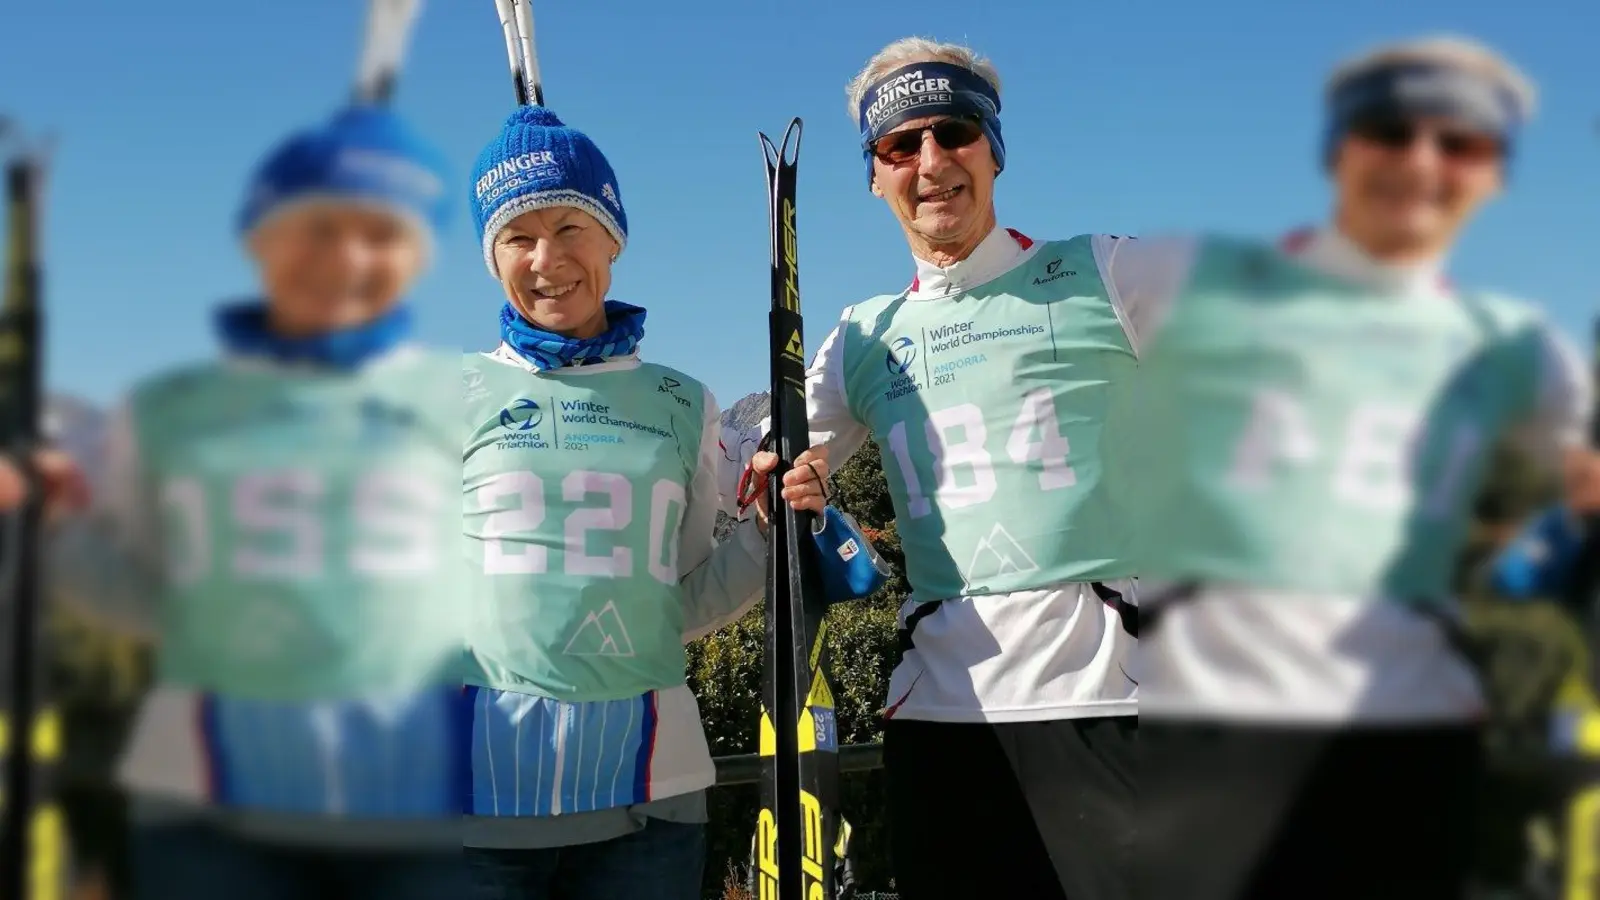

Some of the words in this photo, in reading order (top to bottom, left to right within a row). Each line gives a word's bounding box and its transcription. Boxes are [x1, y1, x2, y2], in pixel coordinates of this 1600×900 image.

[876, 70, 922, 97] TEAM
[866, 78, 953, 125] ERDINGER
[476, 151, 559, 198] ERDINGER
[1032, 270, 1077, 285] Andorra
[930, 320, 974, 341] Winter
[931, 334, 960, 354] World
[961, 324, 1044, 345] Championships
[934, 354, 987, 374] ANDORRA
[891, 374, 915, 389] World
[934, 373, 956, 386] 2021
[885, 383, 922, 401] Triathlon
[561, 400, 610, 413] Winter
[562, 414, 596, 424] World
[496, 440, 549, 450] Triathlon
[504, 432, 540, 441] World
[564, 434, 625, 444] ANDORRA
[565, 442, 589, 450] 2021
[887, 387, 1077, 519] 184
[478, 470, 687, 586] 220
[814, 712, 826, 742] 220
